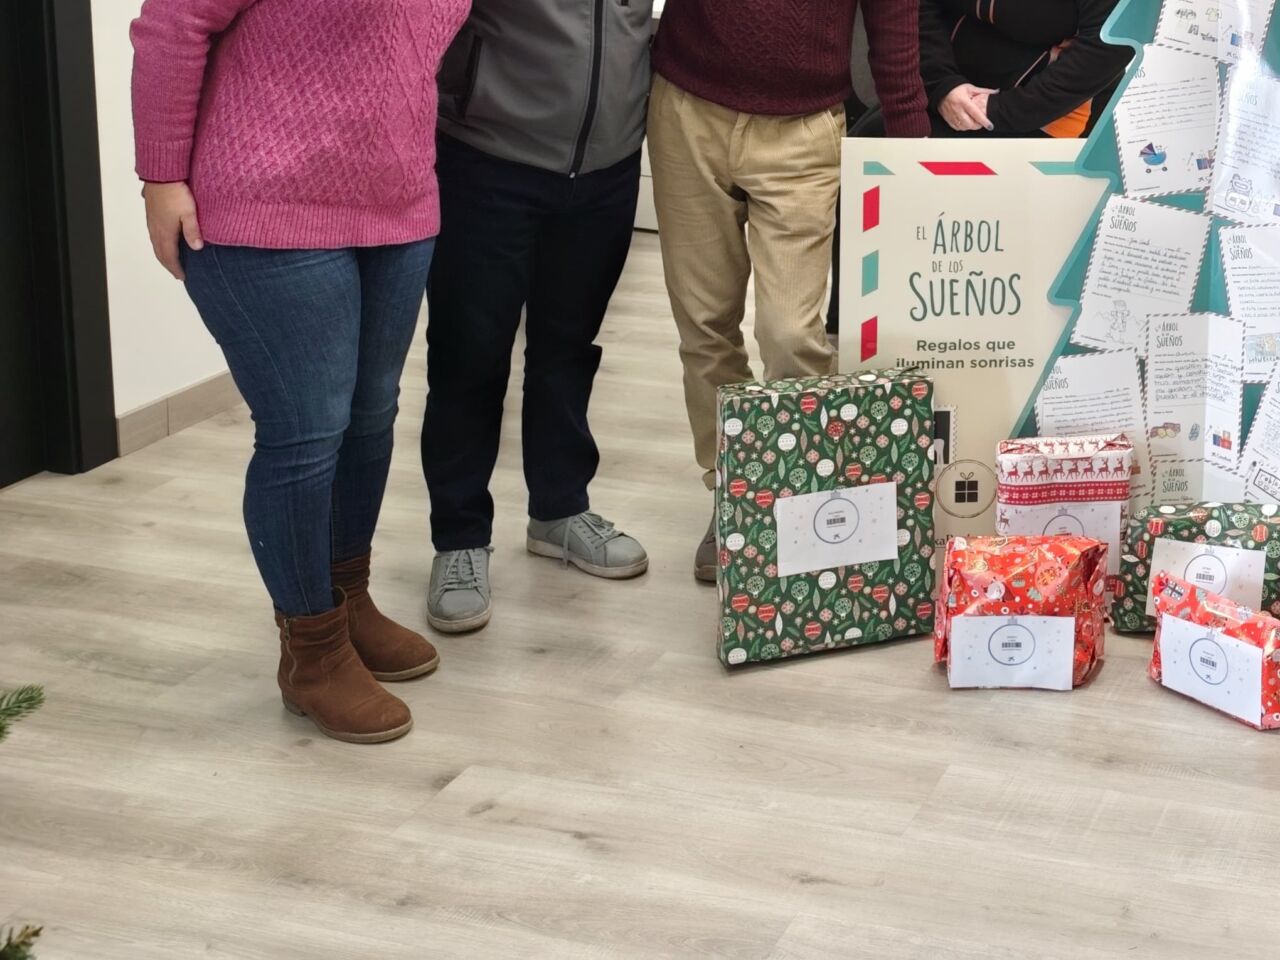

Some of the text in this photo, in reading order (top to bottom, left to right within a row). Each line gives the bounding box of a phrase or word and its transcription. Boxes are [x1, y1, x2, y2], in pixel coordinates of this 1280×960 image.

[1109, 215, 1137, 233] SUEÑOS
[916, 211, 1004, 255] EL ÁRBOL
[1229, 246, 1253, 261] SUEÑOS
[932, 259, 963, 273] DE LOS
[908, 270, 1021, 322] SUEÑOS
[916, 339, 1016, 354] Regalos que
[1156, 333, 1183, 348] SUEÑOS
[896, 356, 1034, 370] iluminan sonrisas
[1162, 478, 1188, 493] SUEÑOS
